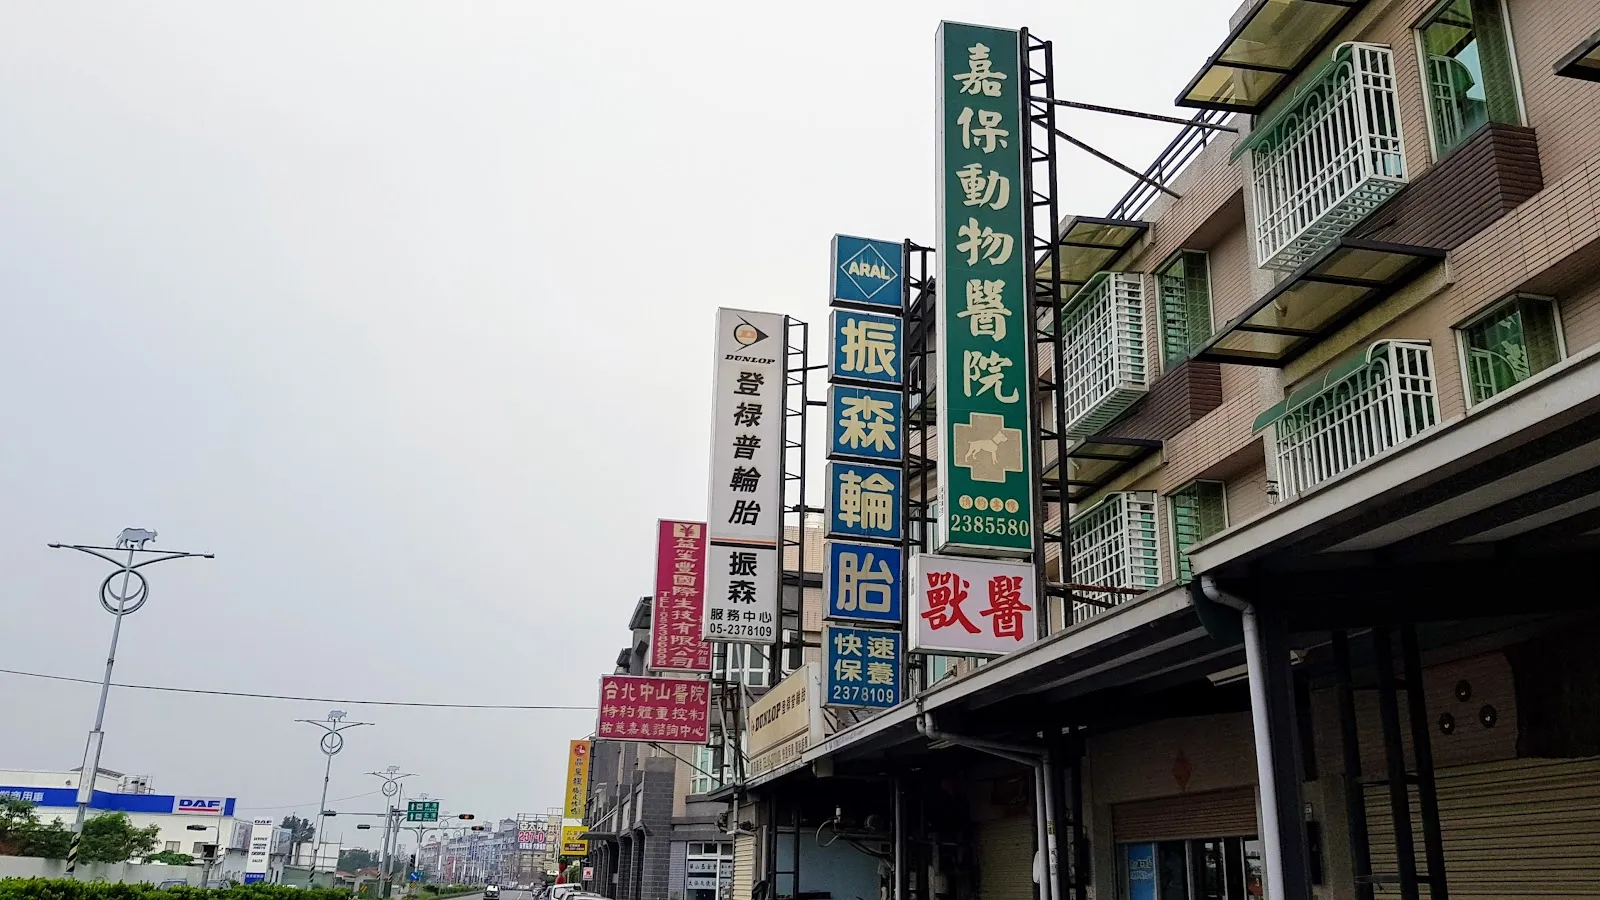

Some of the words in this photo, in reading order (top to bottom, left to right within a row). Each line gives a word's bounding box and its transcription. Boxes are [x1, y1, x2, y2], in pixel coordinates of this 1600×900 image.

[953, 42, 1019, 403] 嘉保動物醫院
[849, 261, 890, 280] ARAL
[725, 354, 776, 364] DUNLOP
[836, 318, 896, 612] 振森輪胎
[951, 514, 1029, 537] 2385580
[727, 551, 757, 604] 振森
[710, 608, 772, 623] 服務中心
[921, 572, 1032, 642] 獸醫
[710, 622, 772, 637] 05-2378109
[834, 632, 895, 660] 快速
[834, 659, 894, 685] 保養
[604, 680, 706, 705] 台北中山醫院
[833, 685, 894, 703] 2378109
[755, 701, 781, 732] DUNLOP
[179, 799, 220, 808] DAF
